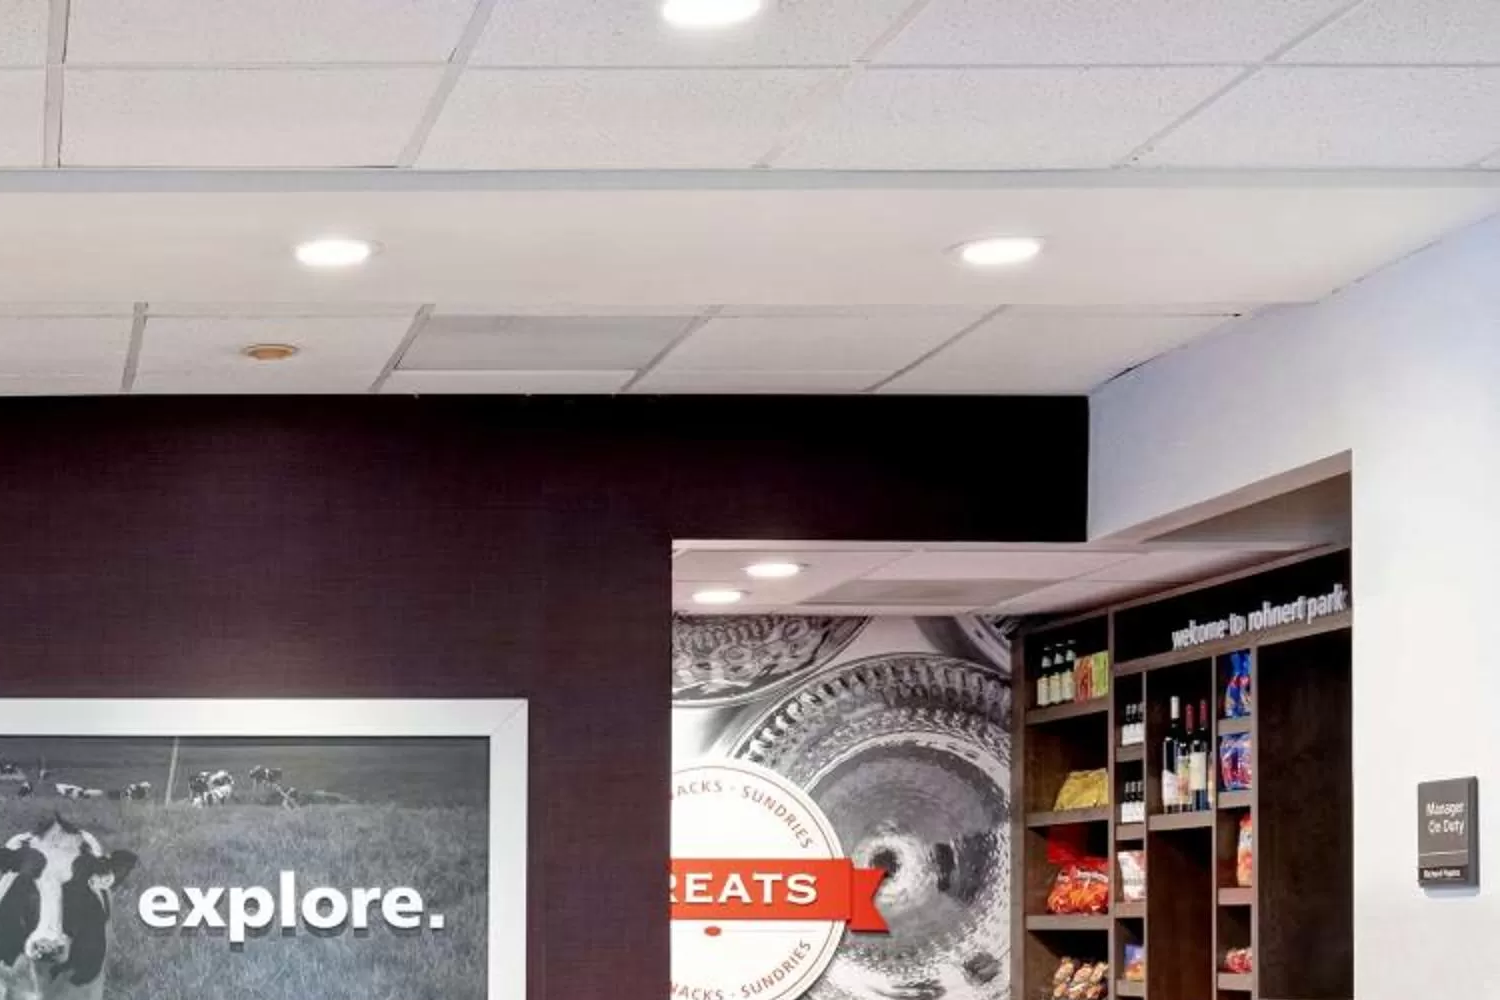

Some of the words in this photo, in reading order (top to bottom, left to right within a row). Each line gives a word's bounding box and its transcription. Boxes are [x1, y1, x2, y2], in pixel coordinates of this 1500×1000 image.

[1172, 619, 1228, 651] welcome
[1229, 612, 1247, 637] to
[1248, 596, 1307, 632] rohnert
[1307, 583, 1348, 625] park
[742, 785, 814, 849] SUNDRIES
[1426, 801, 1465, 817] Manager
[1428, 820, 1442, 834] On
[1443, 819, 1465, 836] Duty
[138, 870, 445, 942] explore.
[740, 940, 812, 998] SUNDRIES
